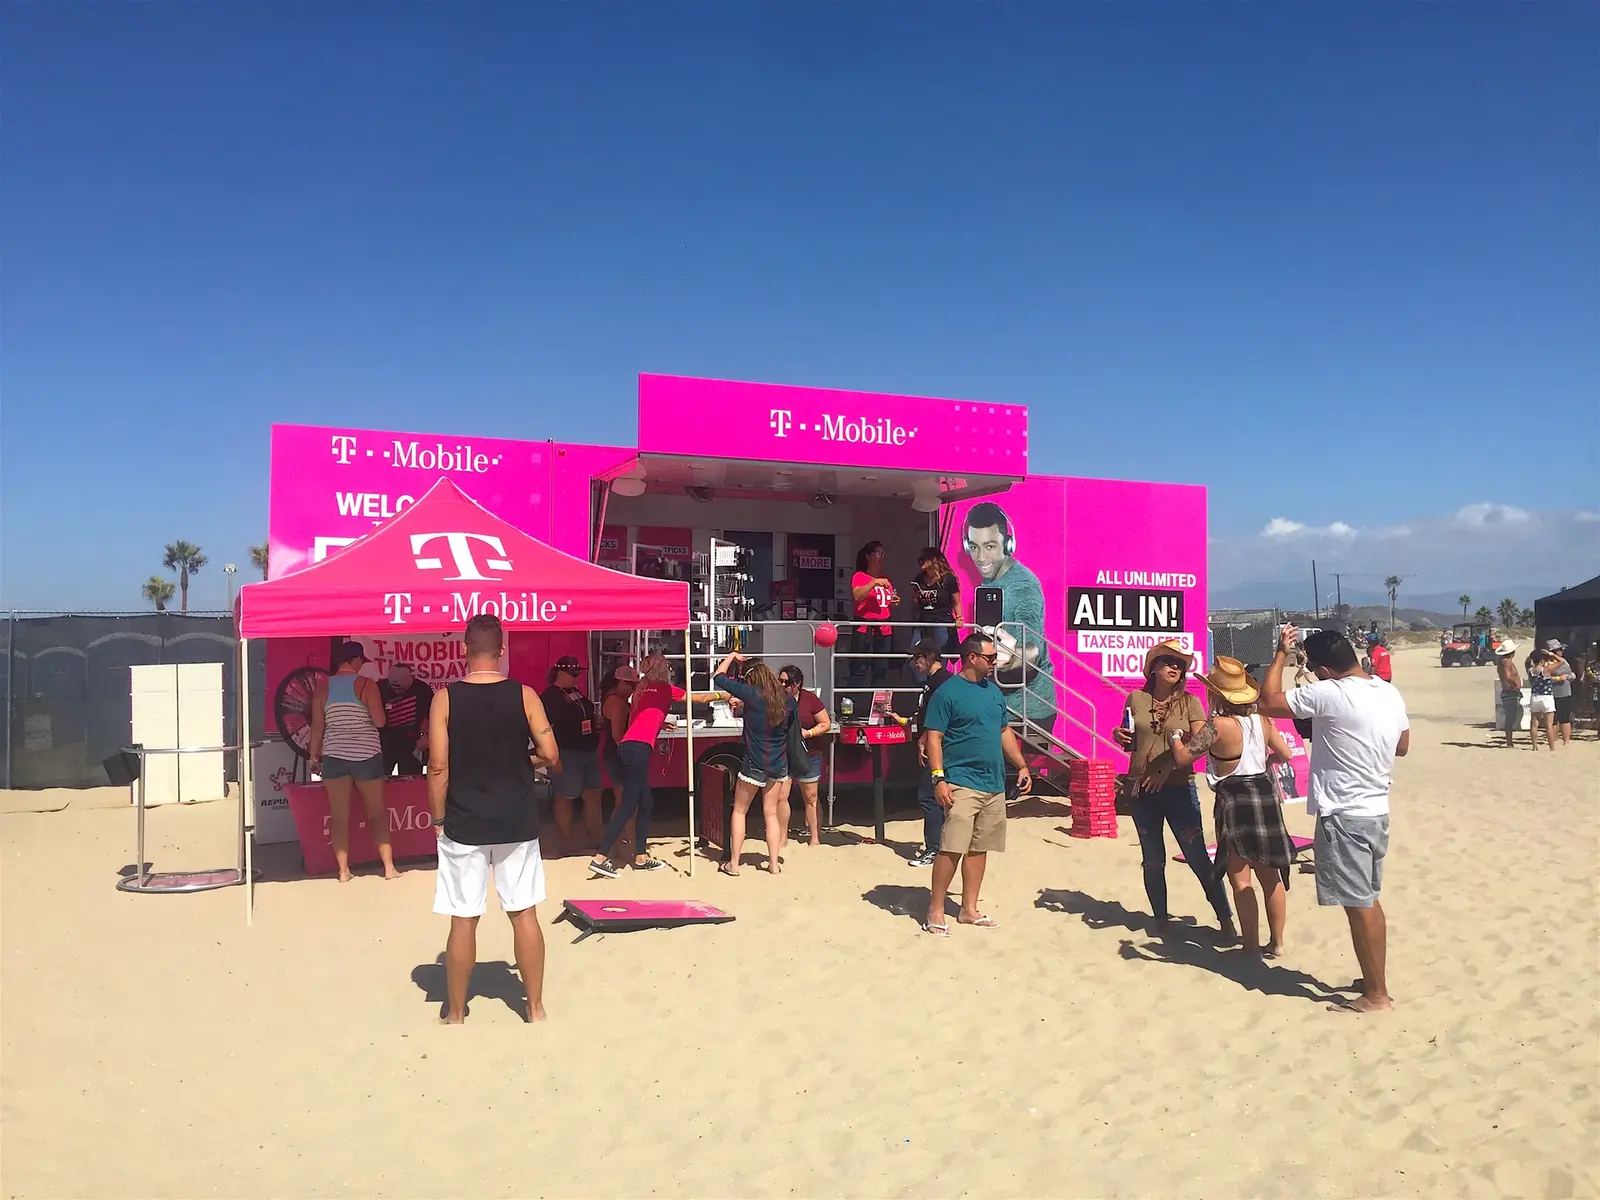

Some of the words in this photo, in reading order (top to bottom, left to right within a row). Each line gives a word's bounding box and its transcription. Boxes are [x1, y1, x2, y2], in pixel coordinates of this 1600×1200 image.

[335, 491, 415, 518] WELC
[410, 532, 513, 581] T
[801, 558, 829, 568] MORE
[1096, 570, 1121, 585] ALL
[1124, 571, 1196, 587] UNLIMITED
[1073, 593, 1132, 626] ALL
[1139, 595, 1178, 627] IN!
[373, 639, 468, 662] T-MOBIL
[1082, 634, 1124, 649] TAXES
[1126, 636, 1155, 649] AND
